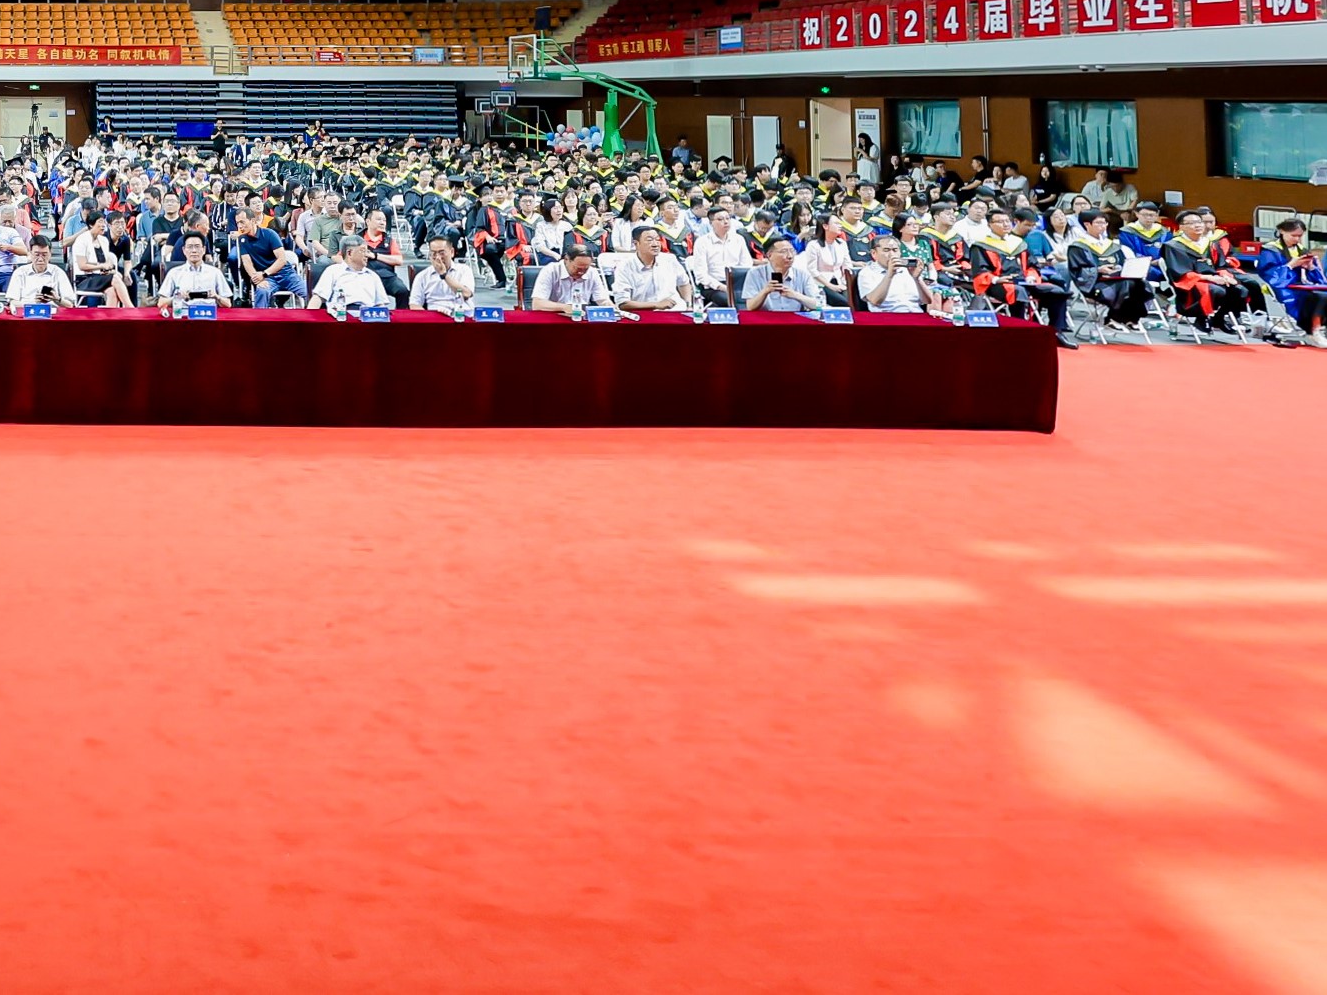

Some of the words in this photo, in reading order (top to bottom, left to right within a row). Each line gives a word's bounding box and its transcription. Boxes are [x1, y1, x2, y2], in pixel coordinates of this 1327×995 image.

[37, 48, 99, 60] 各自建功名
[107, 49, 170, 60] 同叙机电情
